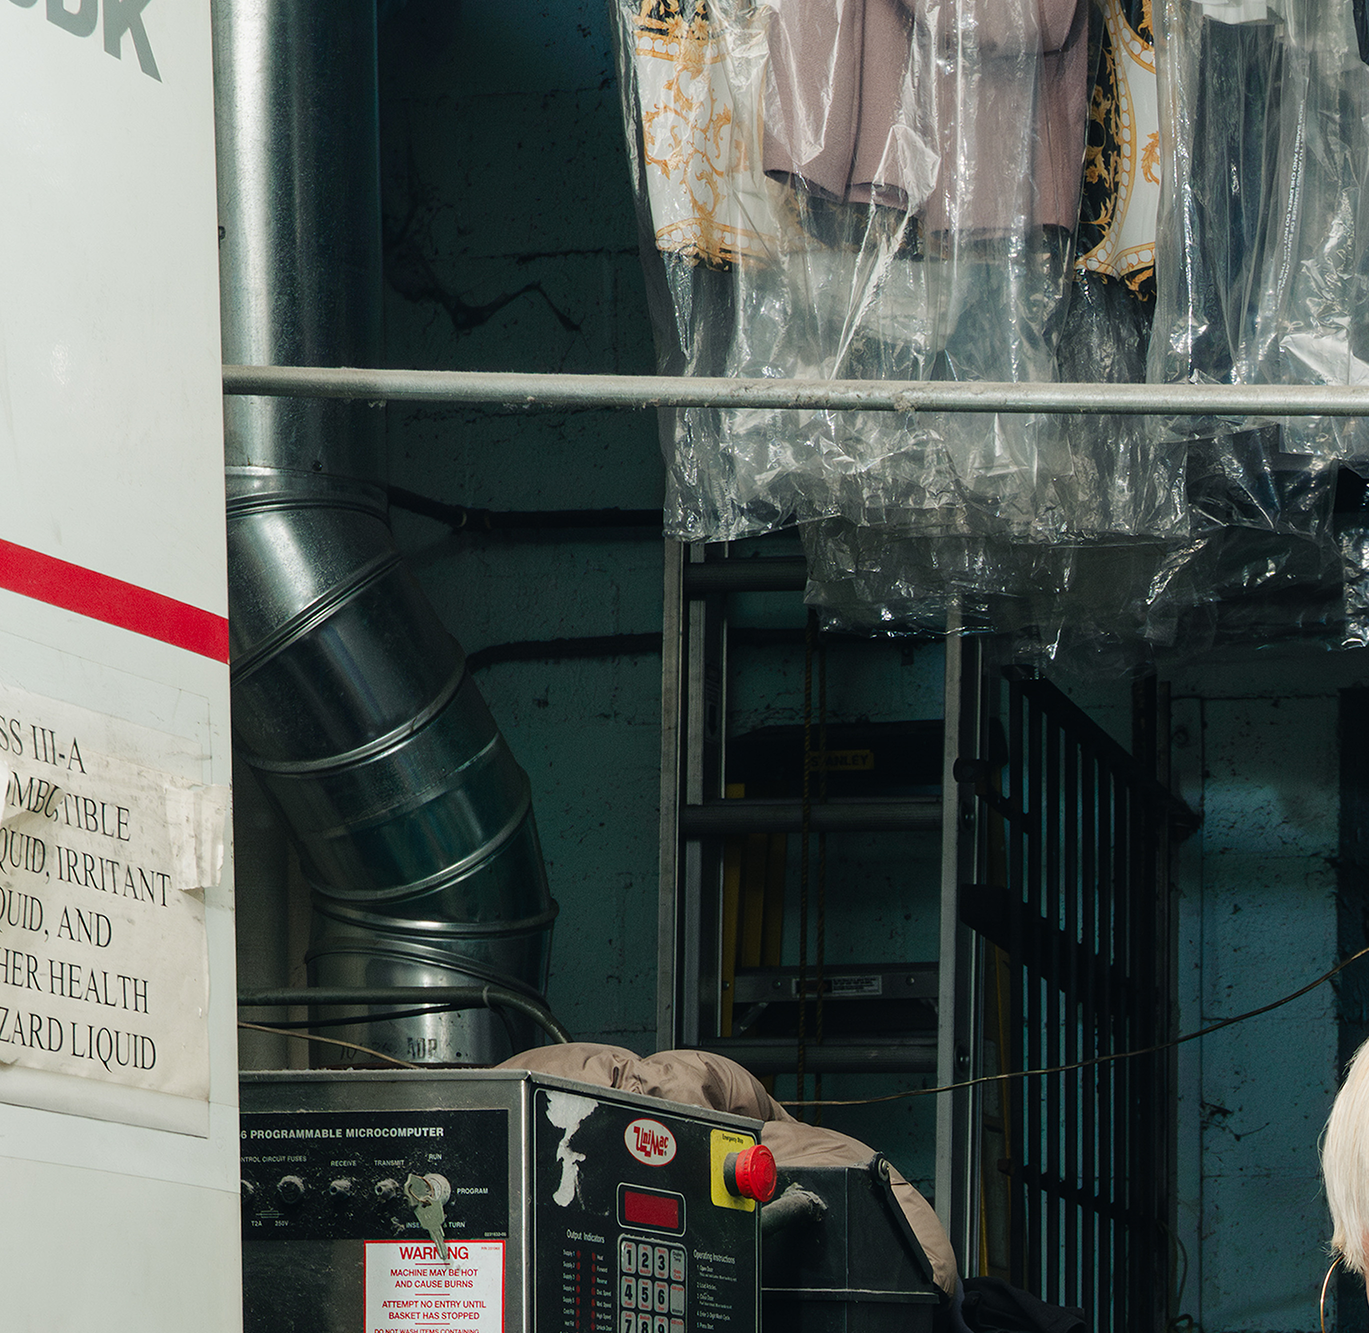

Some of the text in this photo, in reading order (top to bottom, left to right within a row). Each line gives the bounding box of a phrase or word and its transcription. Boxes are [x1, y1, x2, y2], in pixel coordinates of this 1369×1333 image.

[30, 723, 87, 775] III-A
[811, 754, 869, 767] SANLEY
[6, 771, 131, 842] MBUTIBLE
[56, 845, 171, 908] IRRITANT
[57, 905, 113, 949] AND
[48, 959, 150, 1015] HEALTH
[71, 1021, 157, 1074] LIQUID
[251, 1128, 343, 1139] PROGRAMMABLE
[346, 1127, 444, 1138] MICROCOMPUTER
[633, 1126, 669, 1158] UniMac
[330, 1159, 357, 1167] RECEIVE
[374, 1159, 405, 1167] TRANSMIT
[428, 1153, 443, 1161] RUN
[456, 1187, 489, 1195] PROGRAM
[448, 1221, 466, 1229] TURN
[399, 1246, 469, 1260] WARNNG
[625, 1250, 632, 1266] 1
[641, 1252, 649, 1268] 2
[658, 1254, 665, 1271] 3
[390, 1269, 479, 1277] MACHINE MAY BE HOT
[395, 1280, 474, 1288] AND CAUSE BURNS
[624, 1285, 633, 1301] 4
[641, 1287, 649, 1303] 5
[658, 1289, 665, 1306] 6
[382, 1300, 487, 1308] ATTEMPT NO ENTRY UNTIL
[388, 1312, 480, 1320] BASKET HAS STOPPED
